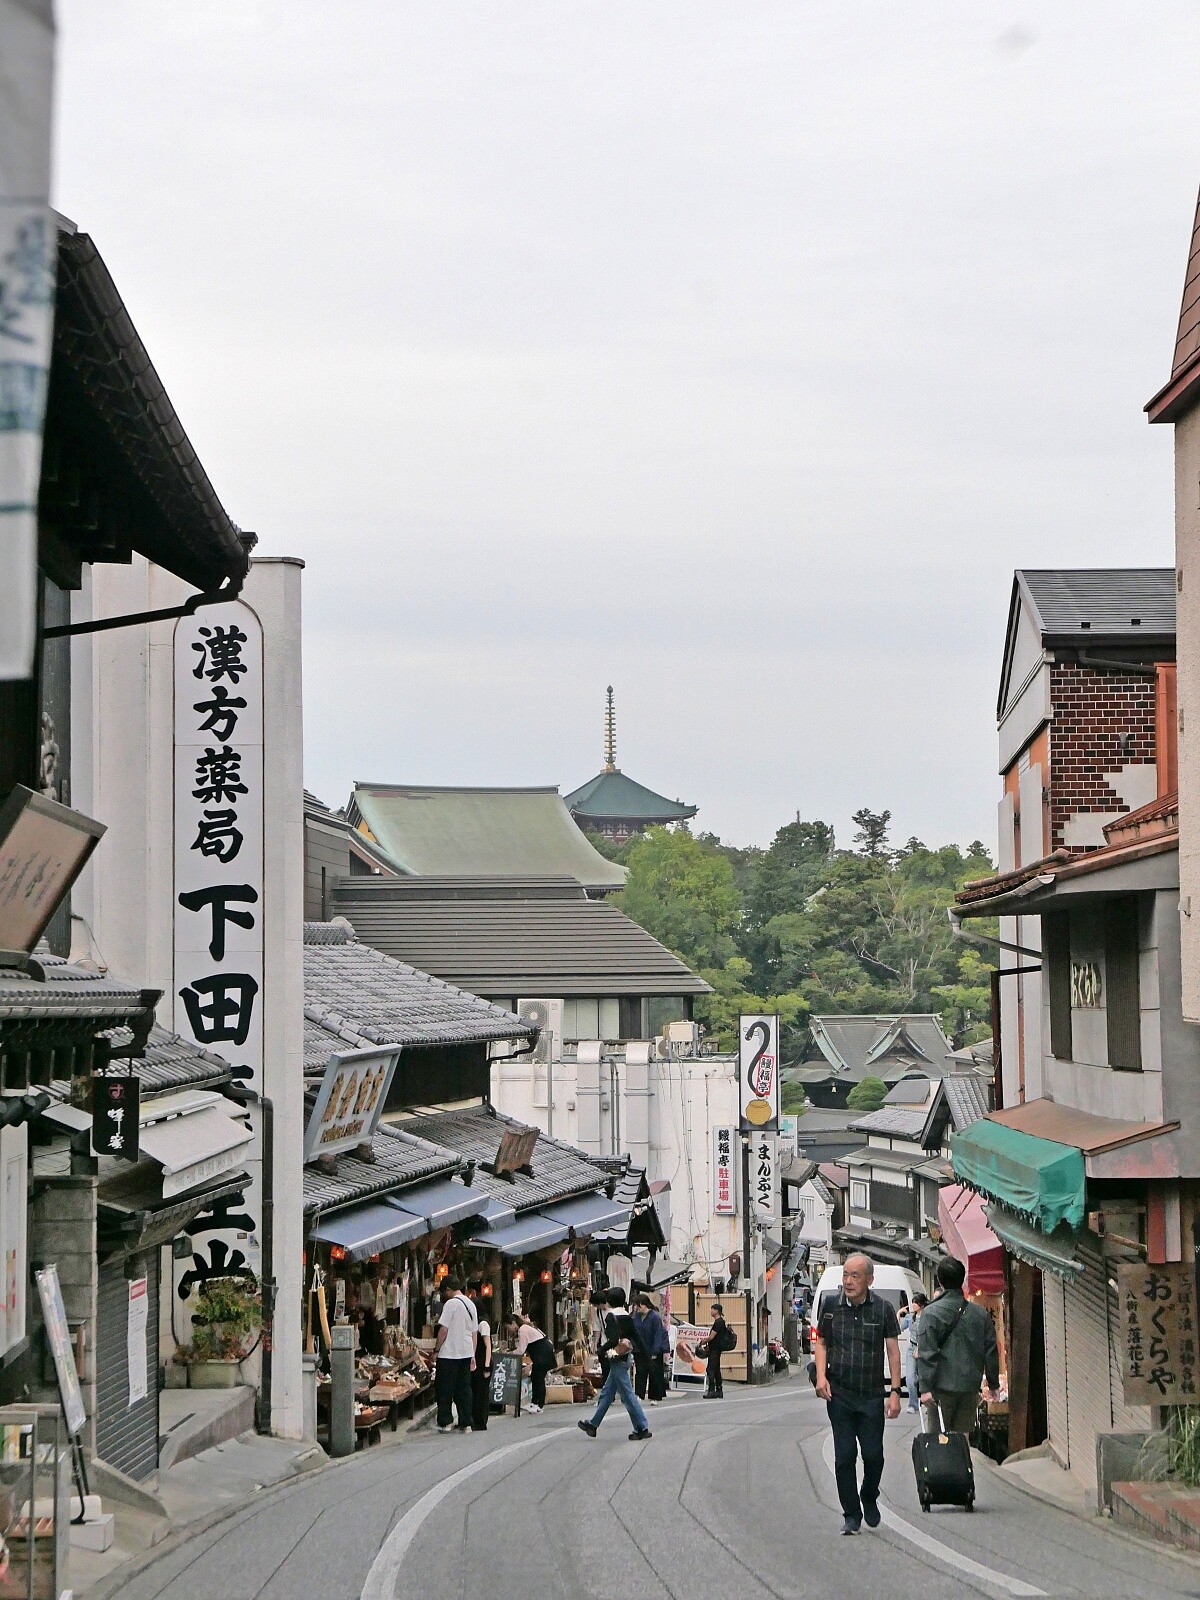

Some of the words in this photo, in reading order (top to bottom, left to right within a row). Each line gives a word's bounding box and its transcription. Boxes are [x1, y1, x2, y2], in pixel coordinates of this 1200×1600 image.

[190, 624, 249, 864] 漢方薬局
[757, 1143, 772, 1209] まんぷく
[1143, 1272, 1176, 1395] おぐらや
